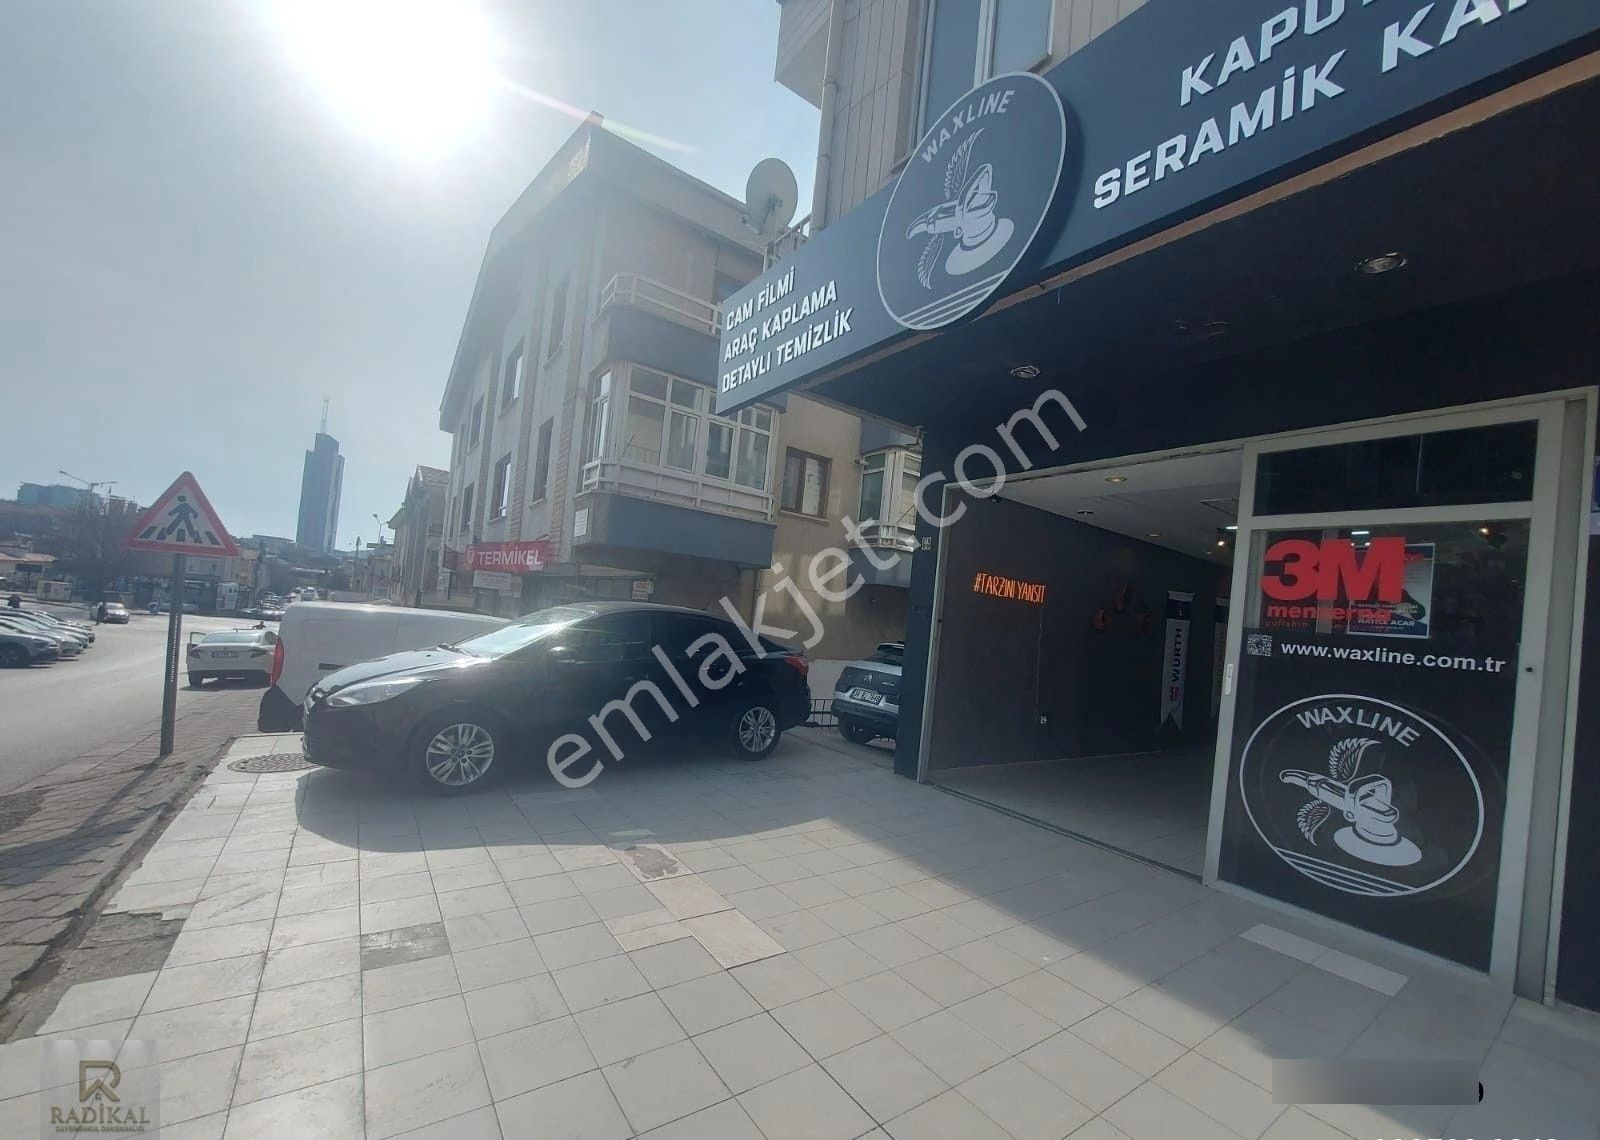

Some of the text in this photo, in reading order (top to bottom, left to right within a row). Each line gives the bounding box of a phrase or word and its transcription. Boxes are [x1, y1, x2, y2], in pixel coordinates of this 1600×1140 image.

[1180, 0, 1373, 106] KAPU
[921, 90, 1014, 164] WAXLINE
[1093, 0, 1528, 209] SERAMİK KA
[723, 280, 837, 363] ARAÇ KAPLAMA
[726, 265, 795, 331] CAM FİLMİ
[721, 307, 854, 393] DETAYLI TEMİZLİK
[477, 546, 542, 566] TERMİKEL
[1261, 536, 1407, 604] 3M
[1280, 641, 1506, 673] www.waxline.com.tr
[1296, 706, 1421, 748] WAXLINE
